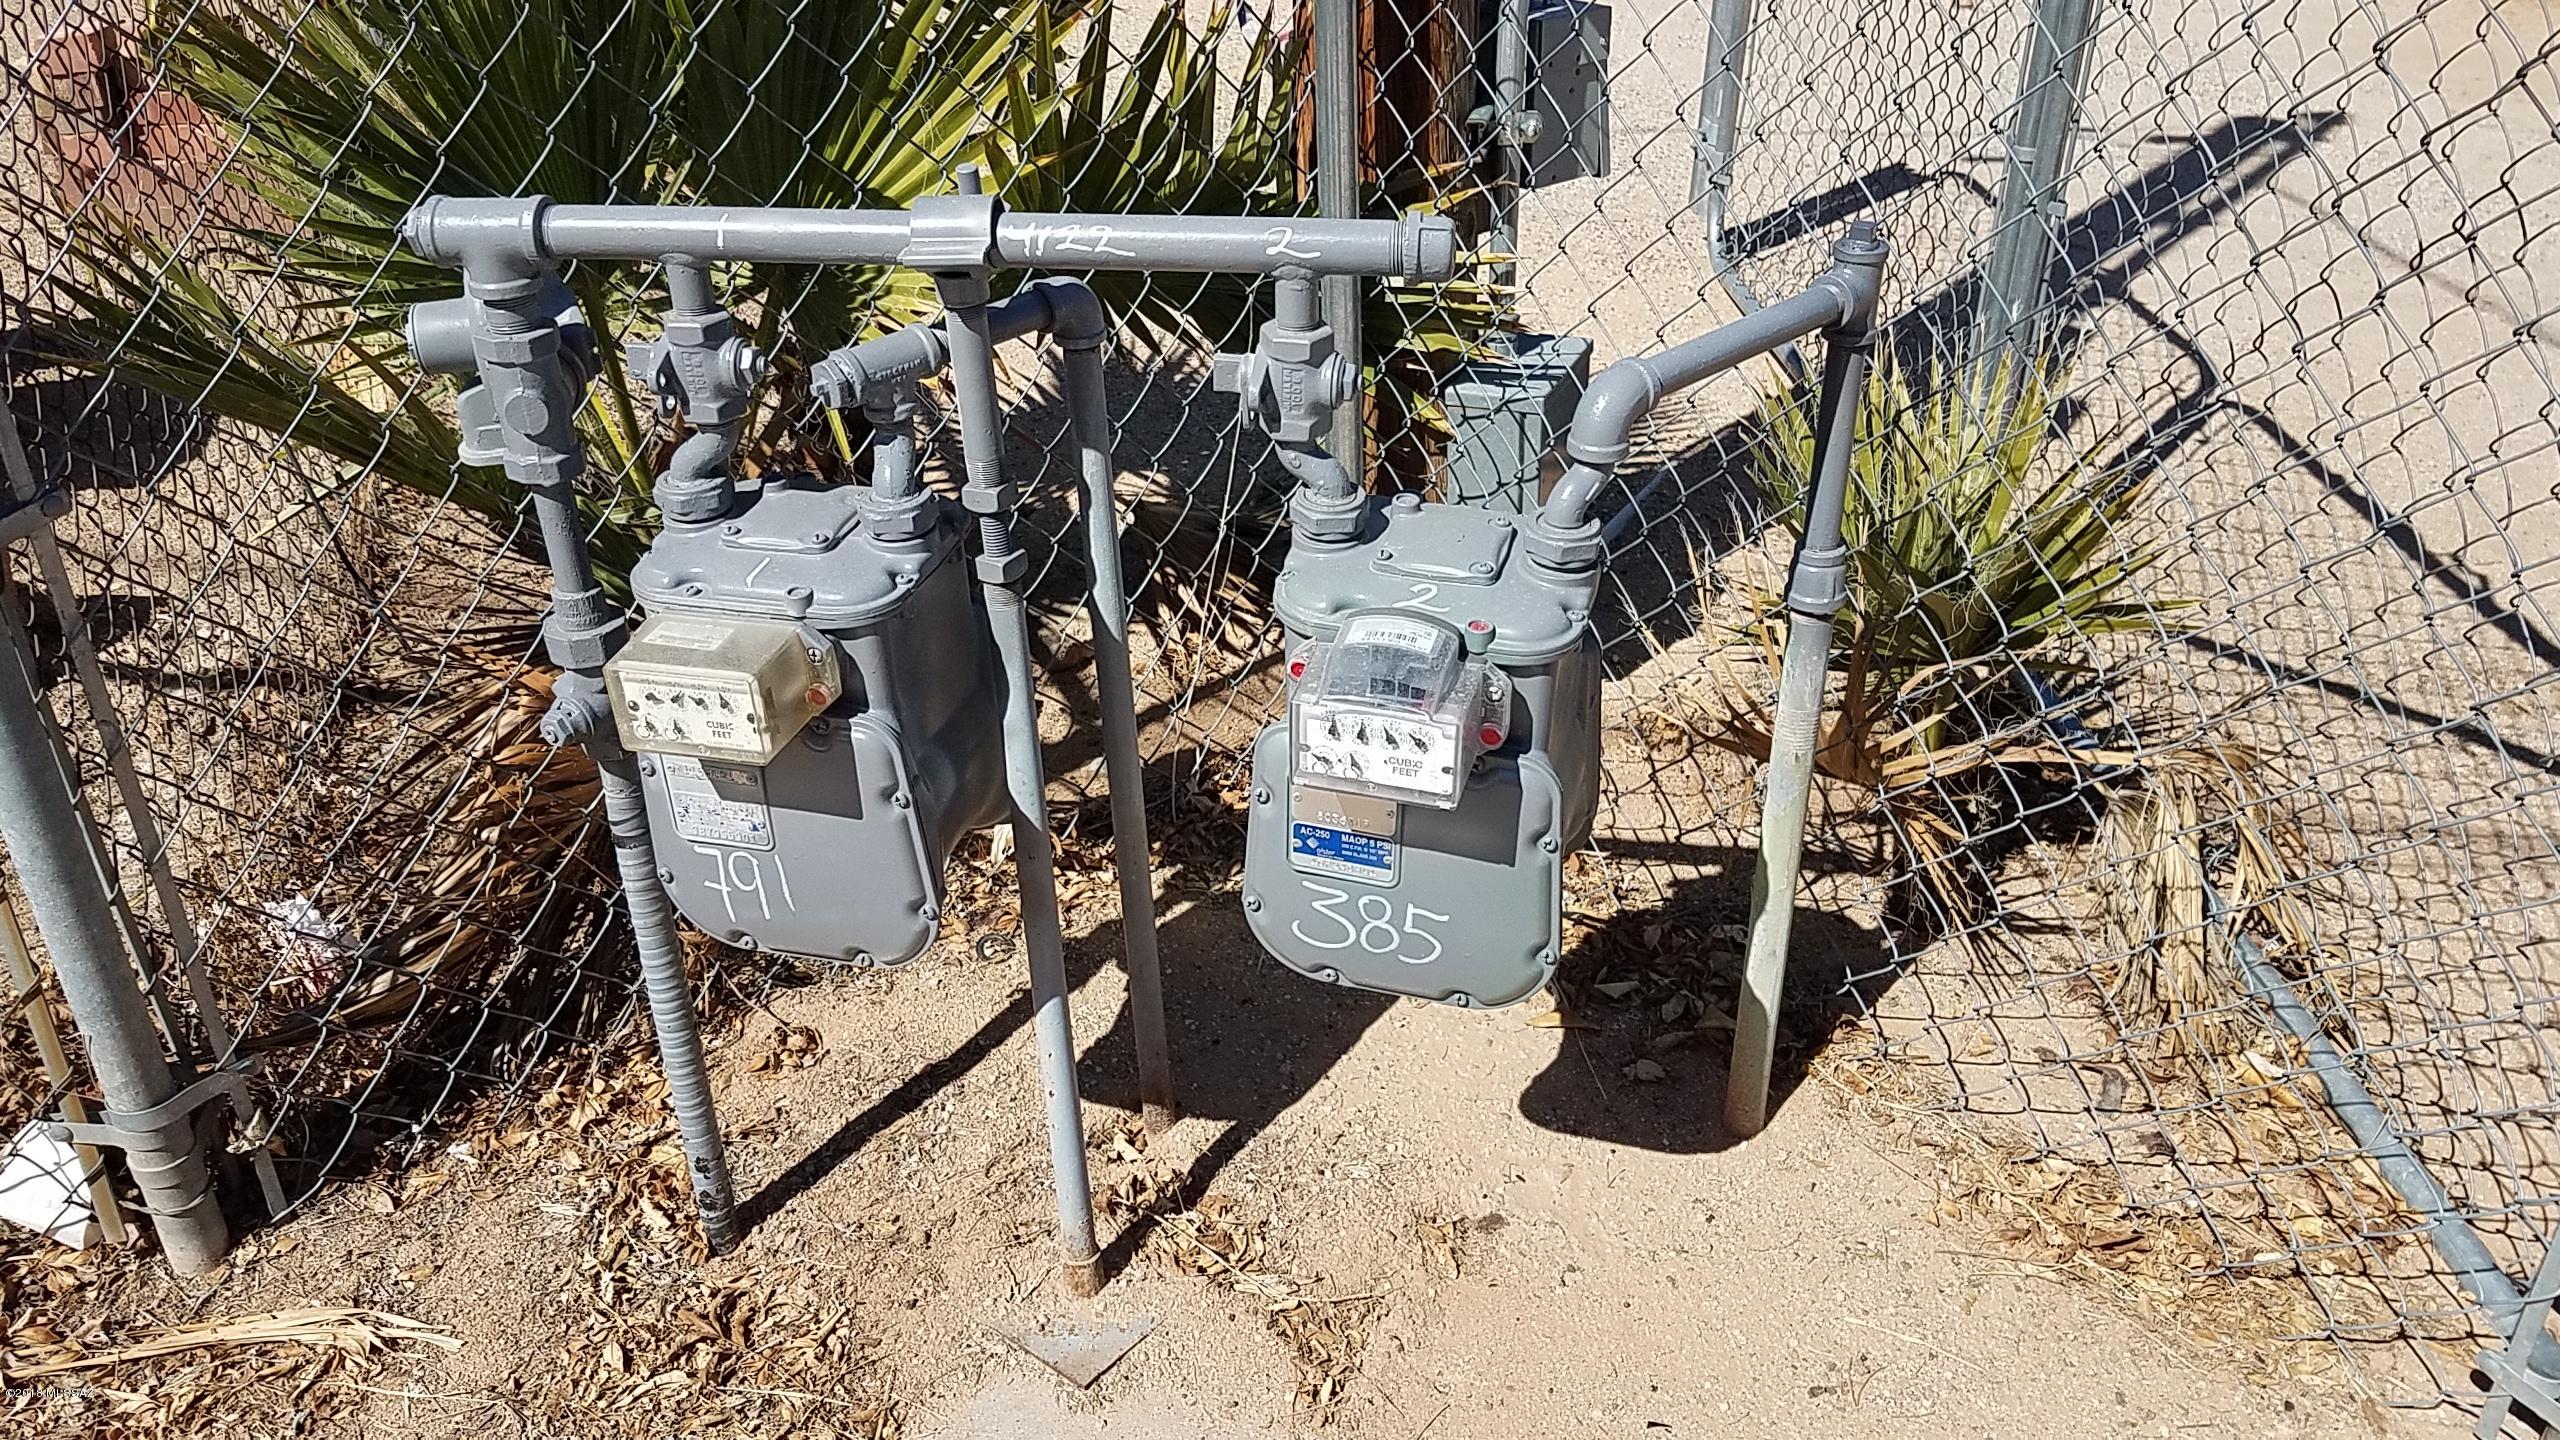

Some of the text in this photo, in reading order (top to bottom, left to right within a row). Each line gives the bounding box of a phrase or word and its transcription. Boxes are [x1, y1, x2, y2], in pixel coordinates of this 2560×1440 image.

[1264, 226, 1322, 259] 2
[1391, 583, 1451, 613] 2
[705, 720, 735, 731] CUBIC
[711, 730, 732, 740] FEET
[1388, 756, 1424, 770] CUBIC
[1392, 767, 1420, 778] FEET
[1300, 826, 1331, 840] AC-250
[1341, 833, 1369, 847] MAOP
[1376, 840, 1393, 850] PSI
[693, 845, 797, 923] 791
[1291, 880, 1450, 964] 385
